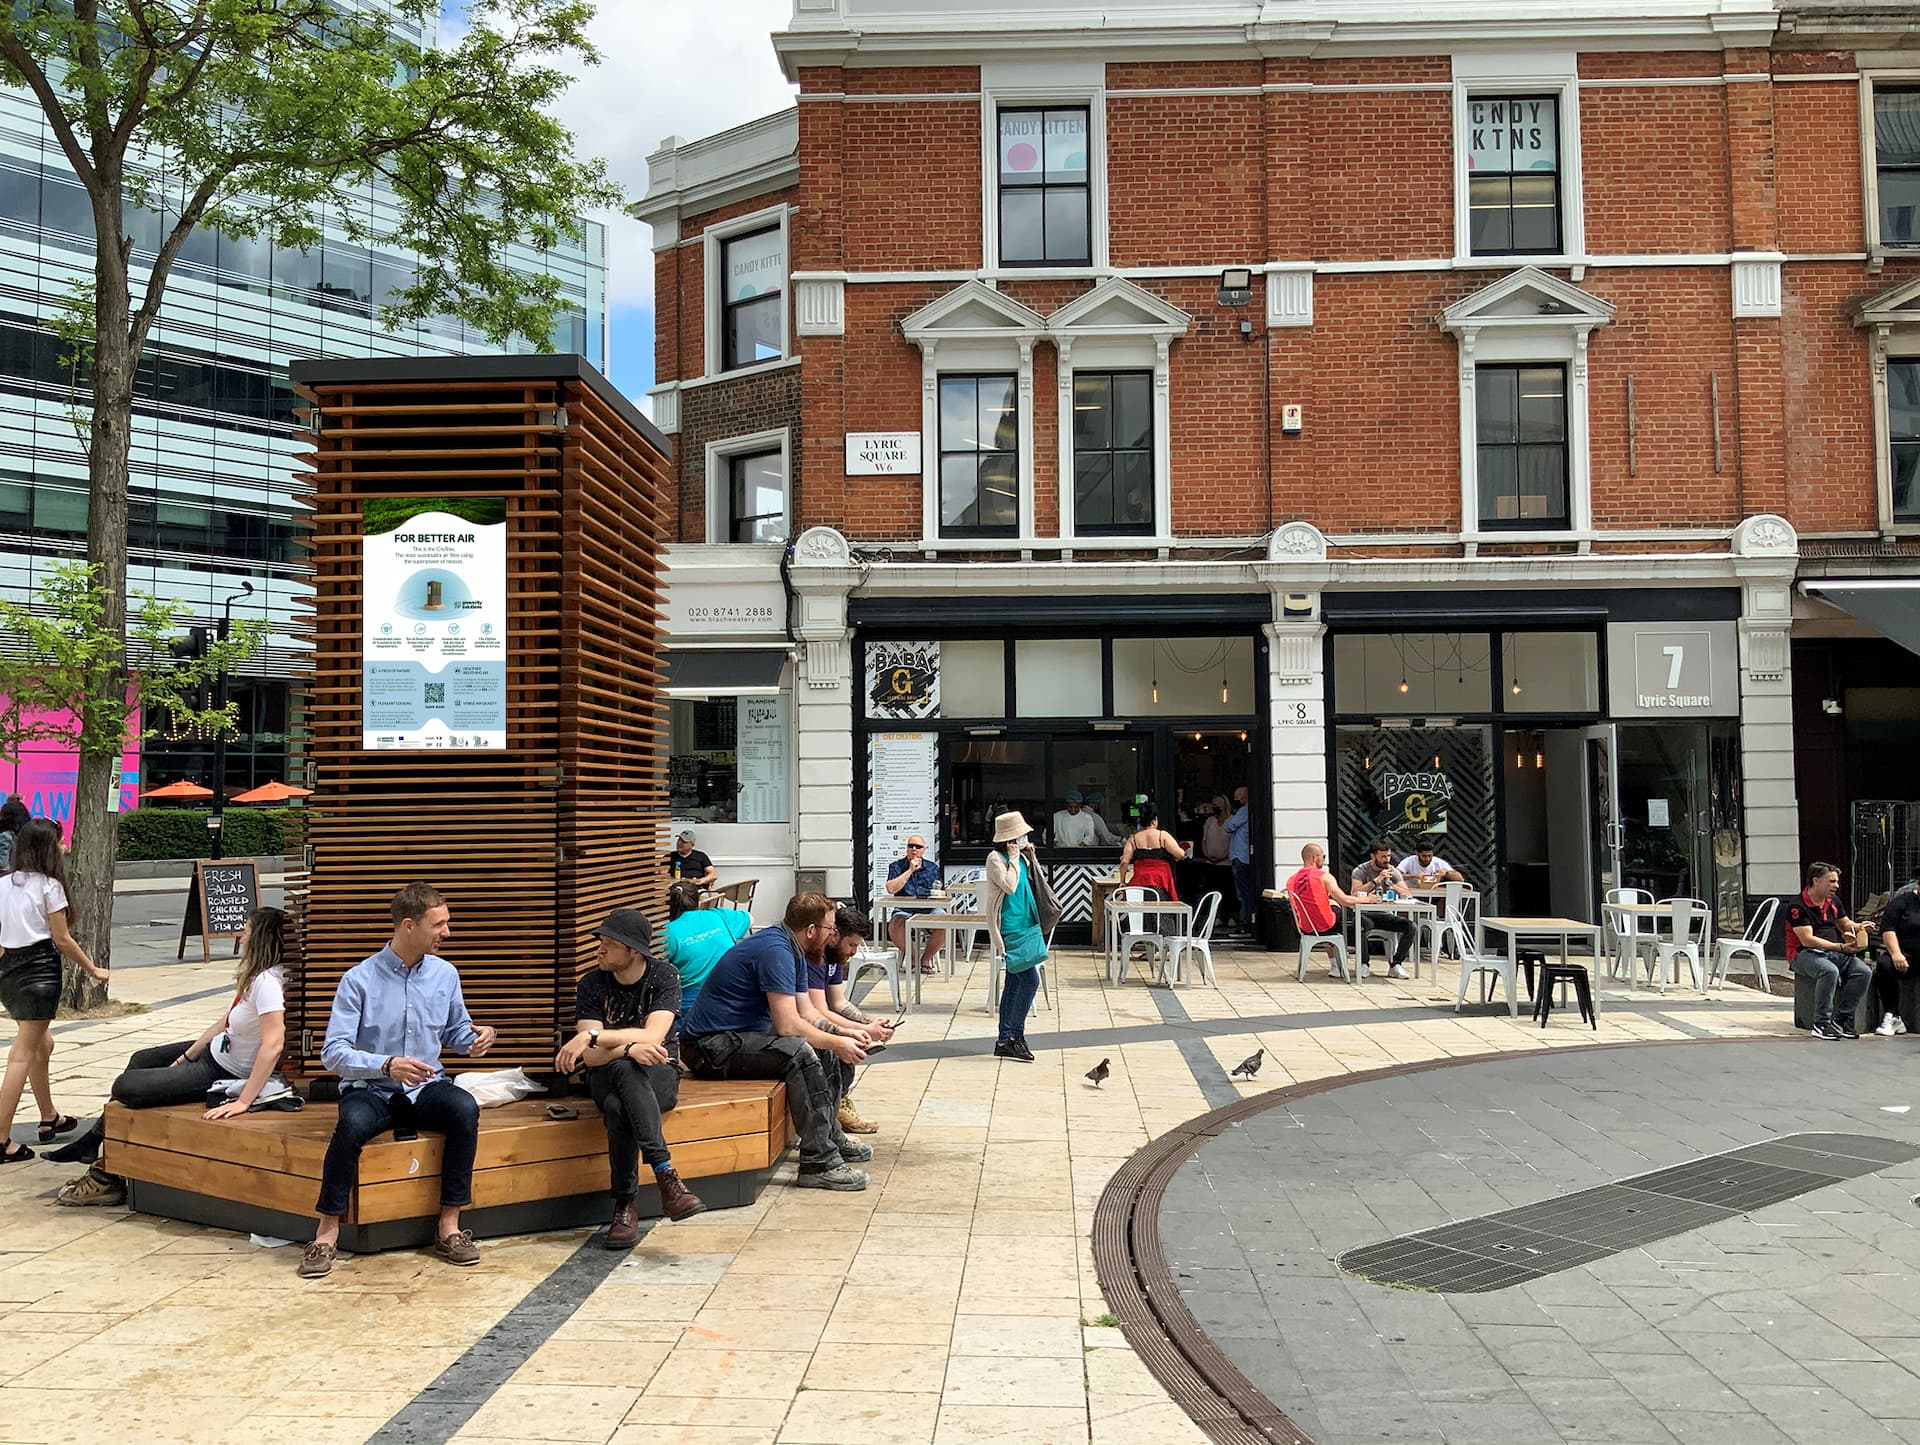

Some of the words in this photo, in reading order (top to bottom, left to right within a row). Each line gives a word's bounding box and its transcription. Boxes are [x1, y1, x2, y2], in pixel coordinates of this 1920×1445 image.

[1472, 102, 1540, 124] CNDY
[1472, 128, 1541, 150] KTNS
[865, 440, 902, 449] LYRIC
[859, 451, 908, 462] SQUARE
[874, 463, 893, 472] W6
[394, 533, 415, 543] FOR
[418, 533, 455, 543] BETTER
[457, 533, 475, 543] AIR
[688, 607, 708, 616] 020
[713, 607, 740, 616] 8741
[746, 607, 773, 616] 2888
[1663, 646, 1683, 688] 7
[1639, 694, 1667, 708] Lyric
[1668, 694, 1710, 708] Square
[1296, 702, 1306, 719] 8
[204, 870, 242, 886] FRESH
[207, 884, 247, 896] SALAD
[207, 896, 250, 906] ROASTED
[1791, 908, 1799, 919] 3
[214, 923, 231, 931] FISH
